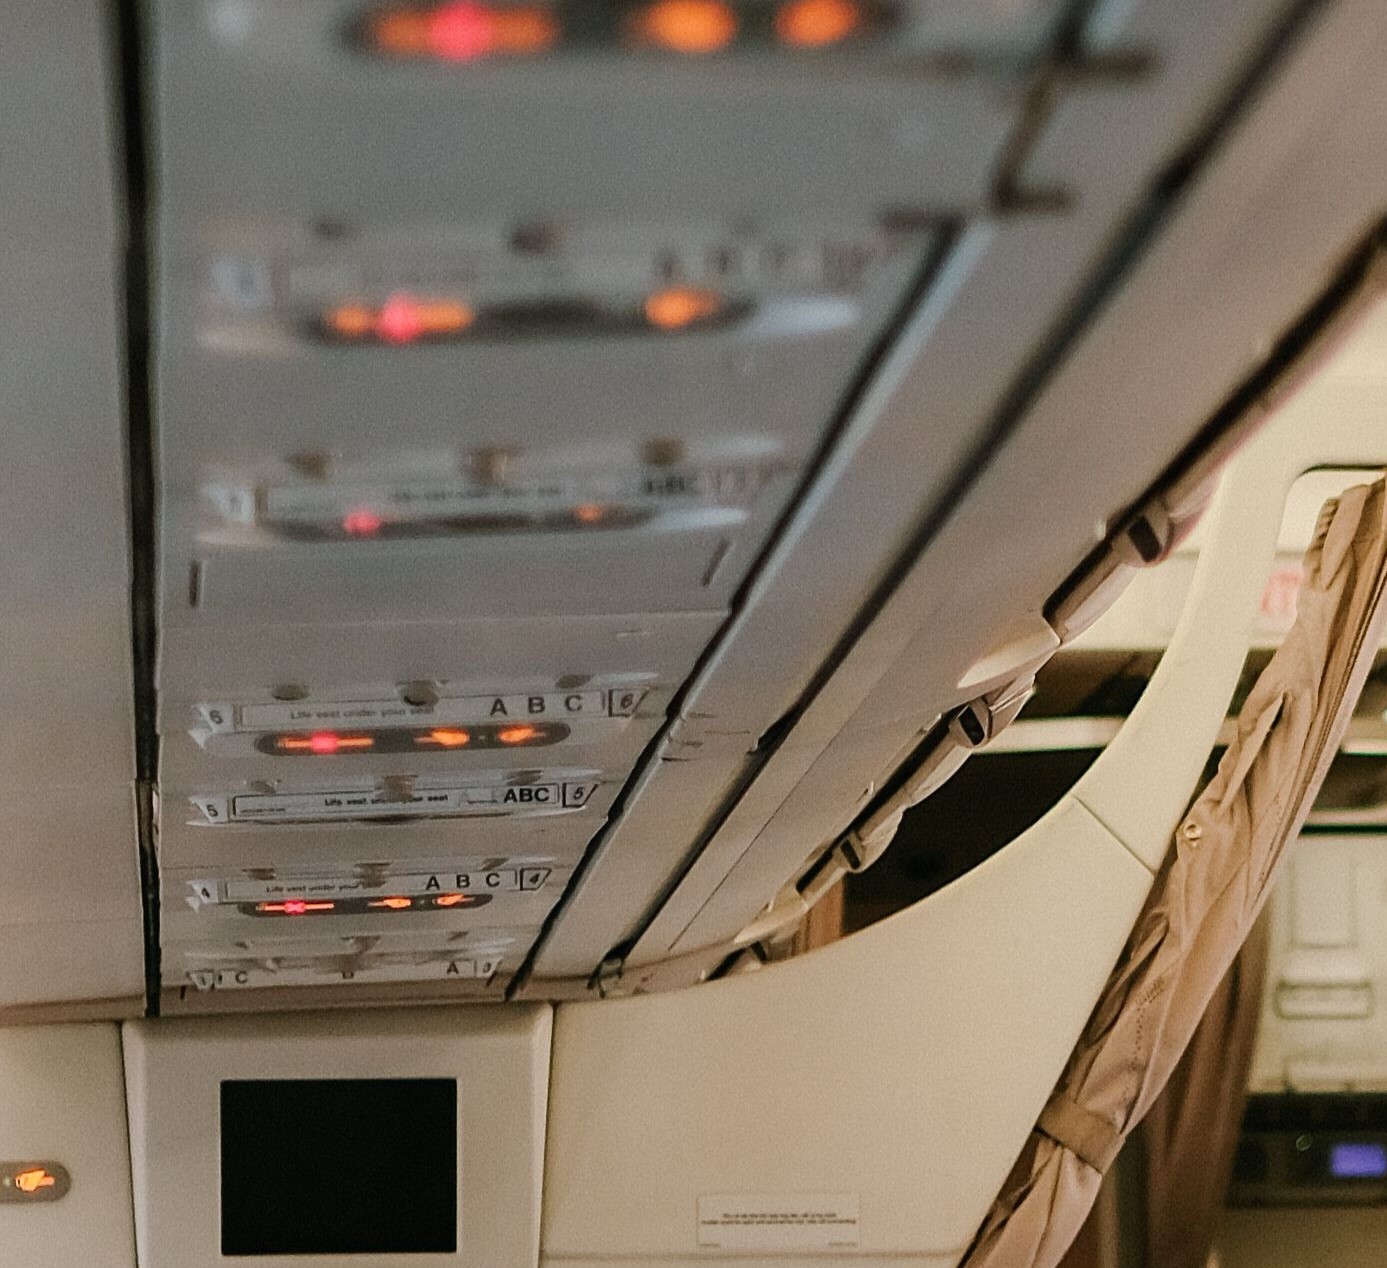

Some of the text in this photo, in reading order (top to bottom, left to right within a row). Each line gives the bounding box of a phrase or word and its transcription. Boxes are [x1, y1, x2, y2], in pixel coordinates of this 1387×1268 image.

[489, 694, 583, 717] A B C
[209, 710, 224, 725] 6
[503, 787, 551, 804] ABC
[572, 786, 585, 800] 5
[206, 804, 219, 818] 5
[425, 872, 501, 891] A B C
[529, 873, 541, 884] 4
[446, 961, 459, 975] A
[234, 971, 249, 984] C
